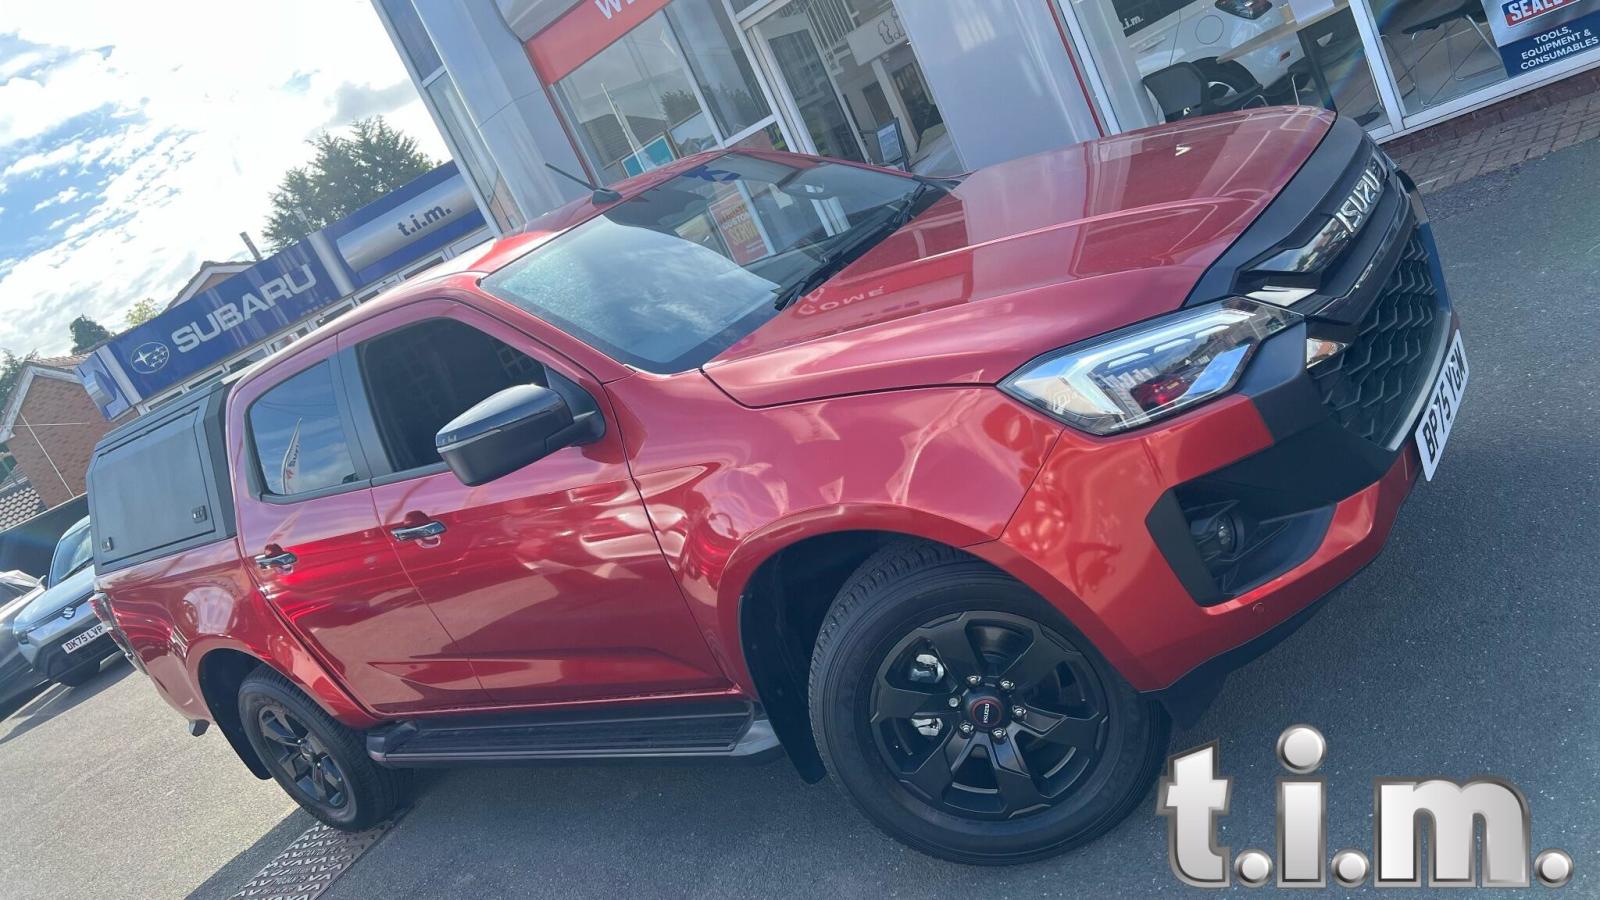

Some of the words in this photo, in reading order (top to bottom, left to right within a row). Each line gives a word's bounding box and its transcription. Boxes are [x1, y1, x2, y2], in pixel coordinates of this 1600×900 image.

[1521, 31, 1581, 60] EQUIPMENT
[1583, 28, 1592, 37] &
[1534, 26, 1572, 44] TOOLS,
[1520, 36, 1600, 70] CONSUMABLES
[1335, 169, 1381, 233] ISUZU
[397, 206, 453, 237] t.i.m.
[171, 263, 317, 354] SUBARU
[1422, 380, 1451, 465] BP75
[65, 634, 88, 651] DK75
[86, 625, 103, 639] LVP
